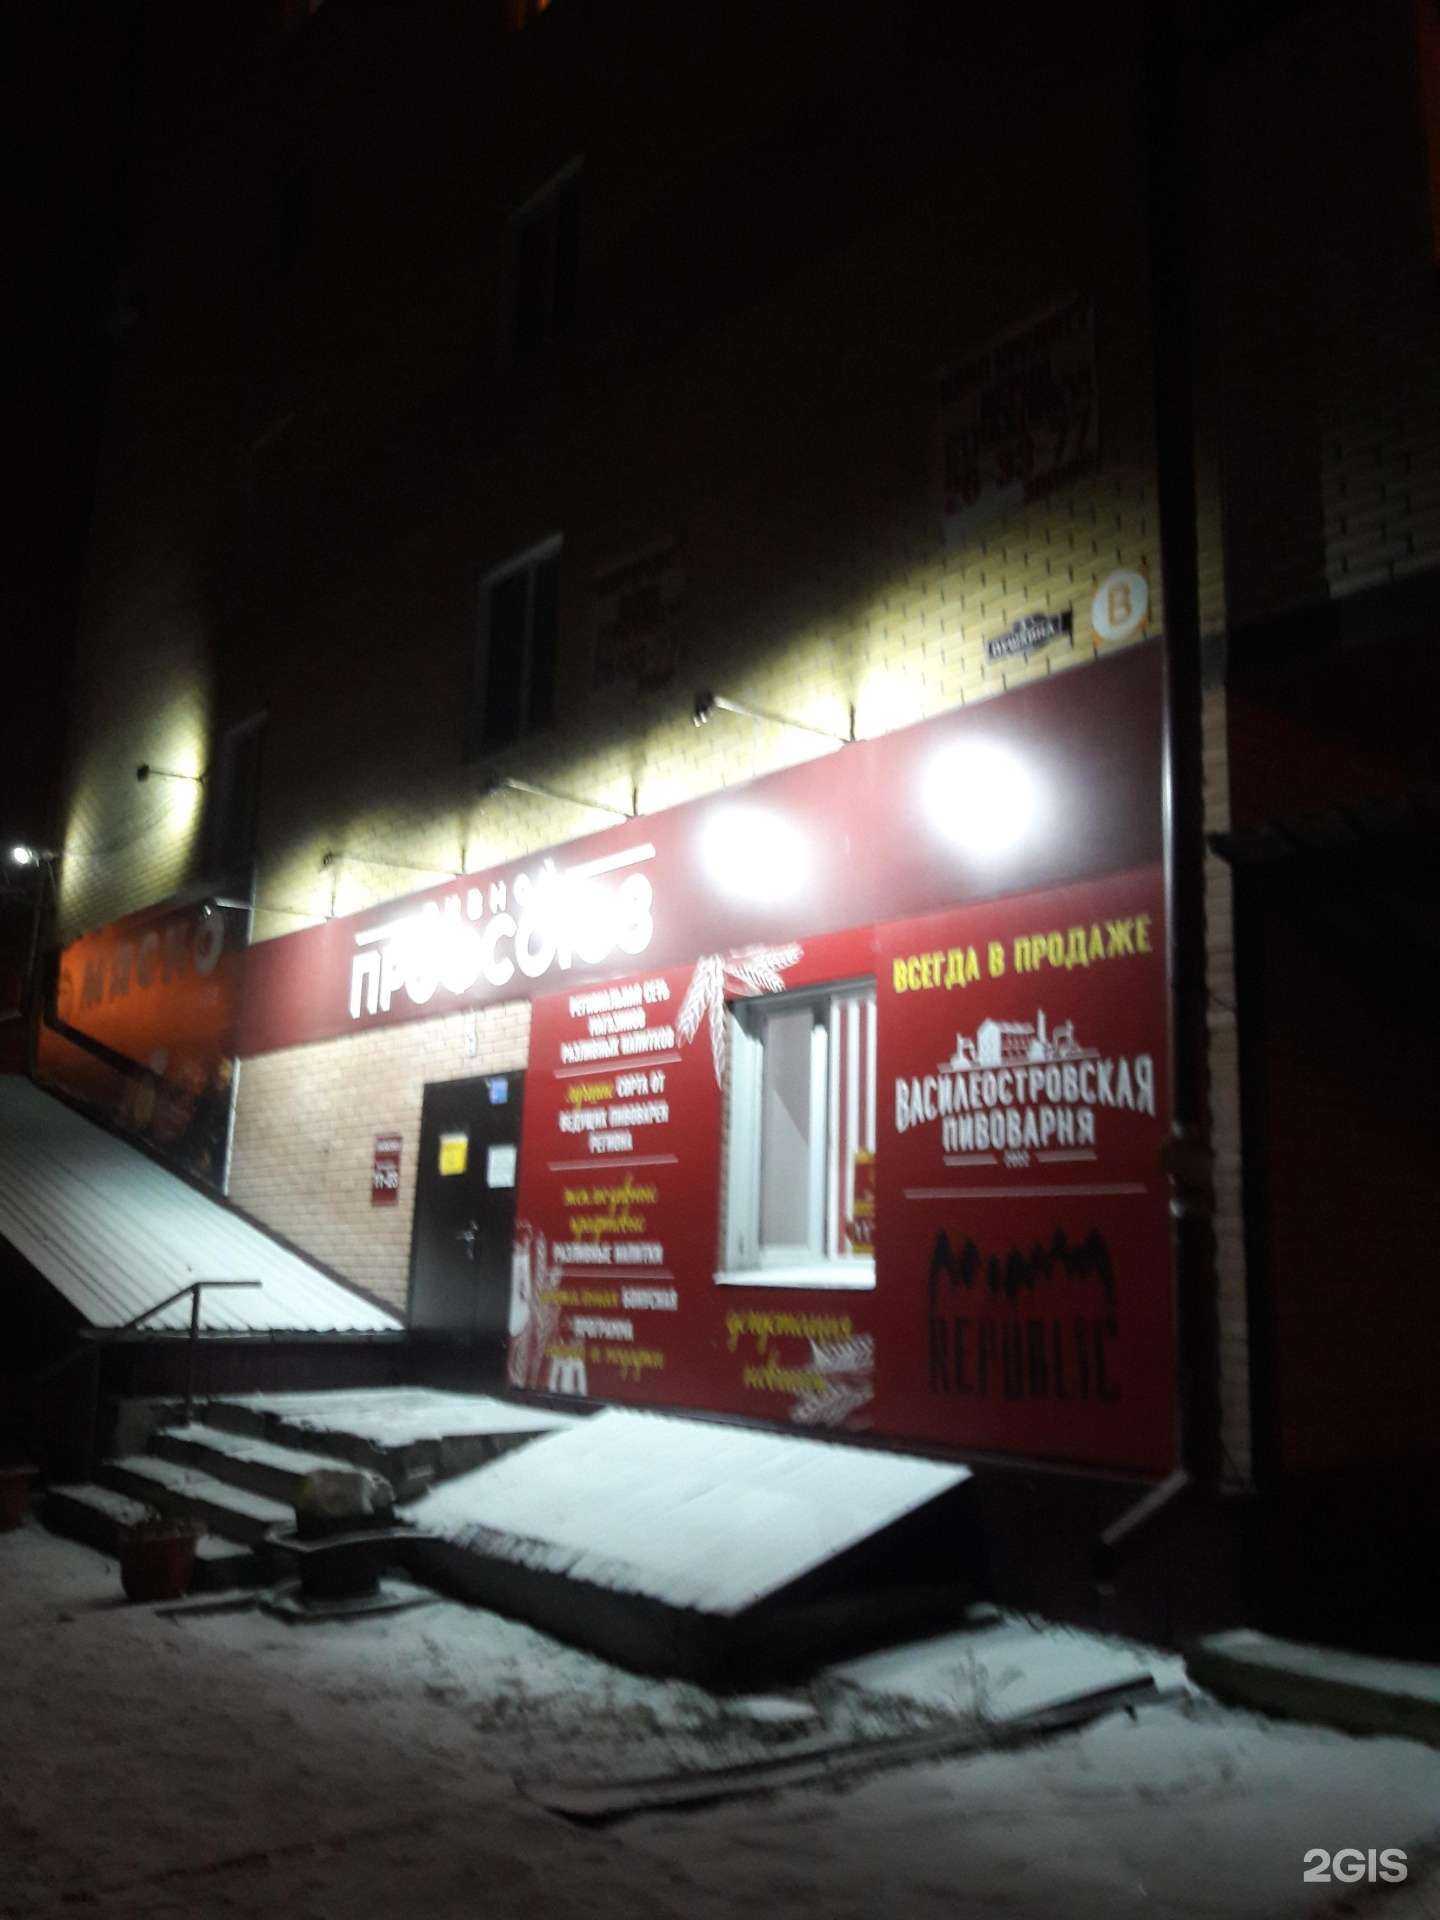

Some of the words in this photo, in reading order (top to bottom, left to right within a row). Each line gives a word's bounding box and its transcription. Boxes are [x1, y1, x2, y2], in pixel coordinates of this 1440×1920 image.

[893, 946, 981, 994] ВСЕГДА
[988, 940, 1005, 977] В
[1014, 912, 1152, 974] ПРОДАЖЕ
[895, 1053, 1156, 1134] ВАСИЛЕОСТРОВСКАЯ
[942, 1106, 1096, 1154] ПИВОВАРНЯ
